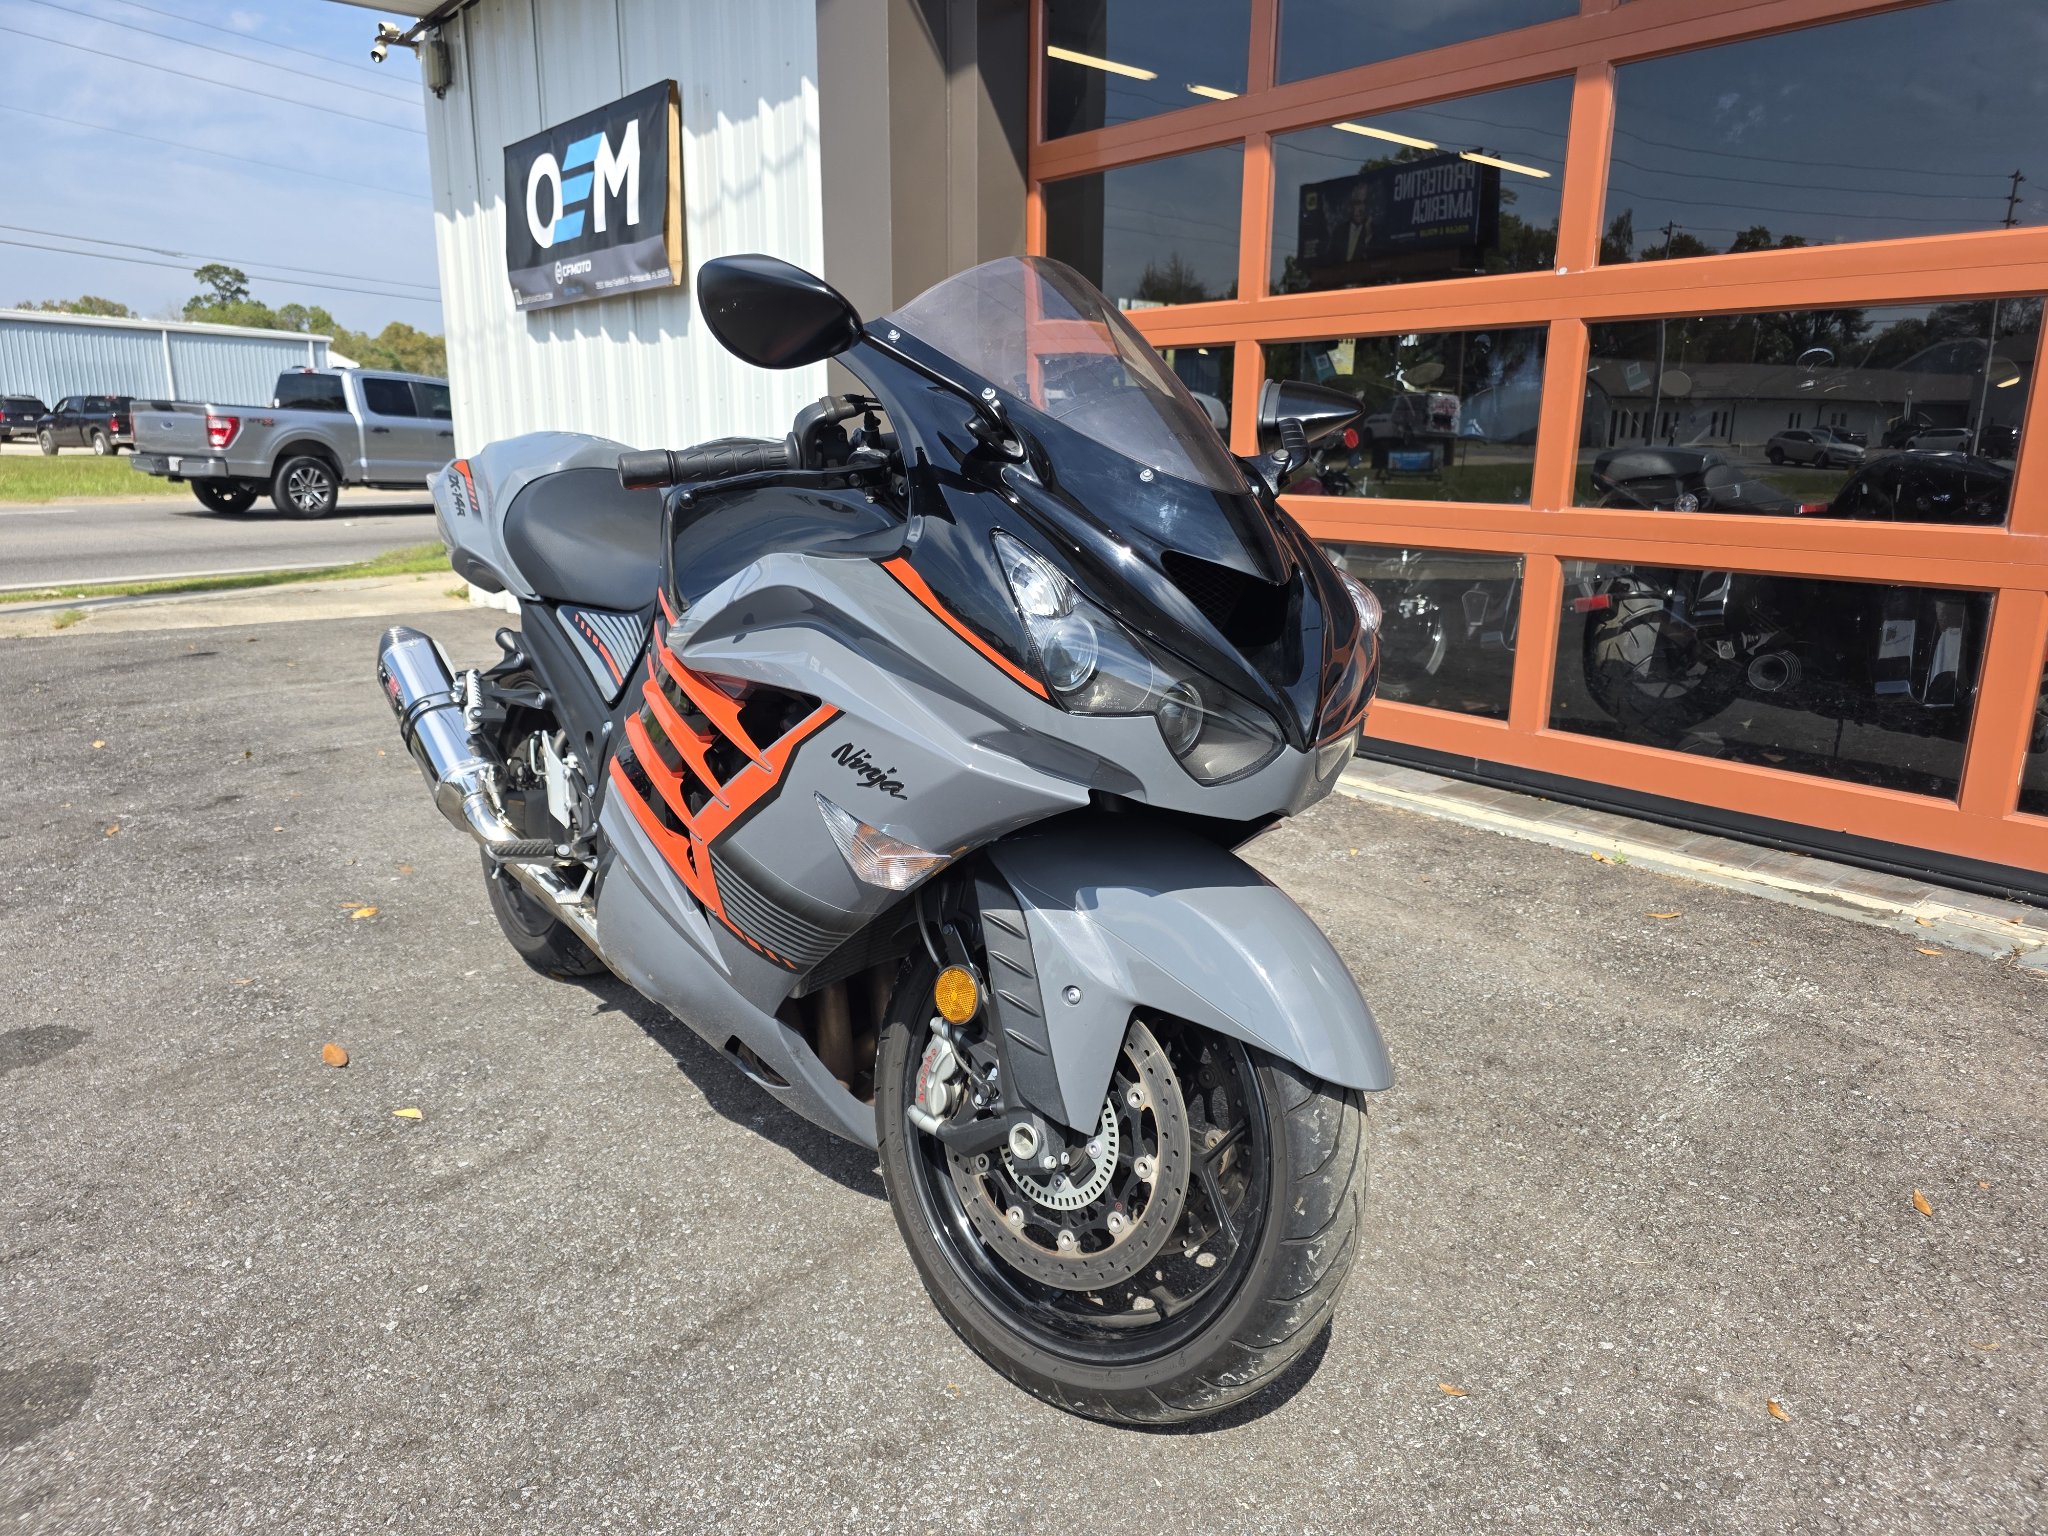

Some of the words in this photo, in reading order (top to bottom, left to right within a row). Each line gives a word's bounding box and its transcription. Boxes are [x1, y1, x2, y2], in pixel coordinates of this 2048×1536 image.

[526, 119, 640, 248] OEM
[562, 259, 591, 277] CFMOTO
[448, 474, 466, 517] ZX-14R
[831, 742, 908, 801] Ninja
[918, 1048, 937, 1102] brembo
[900, 1181, 946, 1276] ROADSMART
